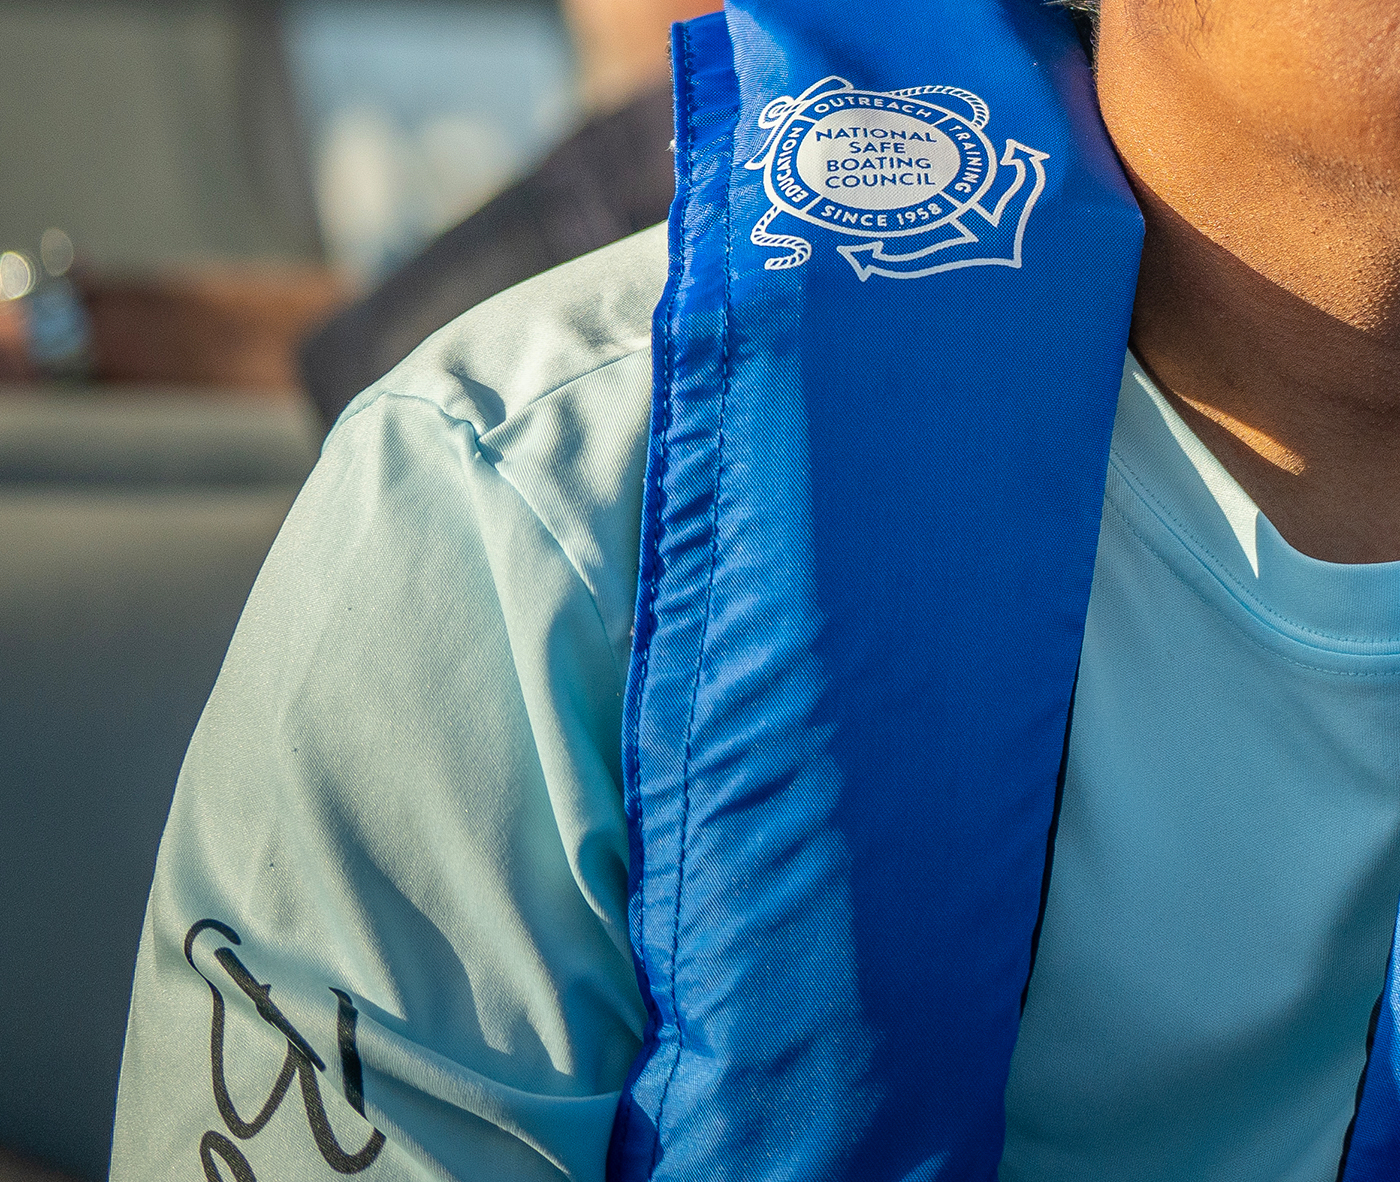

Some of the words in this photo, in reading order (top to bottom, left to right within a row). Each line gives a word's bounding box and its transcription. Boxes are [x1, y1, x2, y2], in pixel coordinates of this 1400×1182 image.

[815, 96, 931, 118] OUTREACH
[816, 127, 937, 143] NATIONAL
[850, 142, 905, 154] SAFE
[776, 126, 808, 202] EDUCATION
[827, 156, 931, 172] BOATING
[948, 125, 982, 194] TRAINING
[825, 173, 935, 188] COUNCIL
[822, 205, 887, 227] SINCE
[897, 203, 942, 225] 1958
